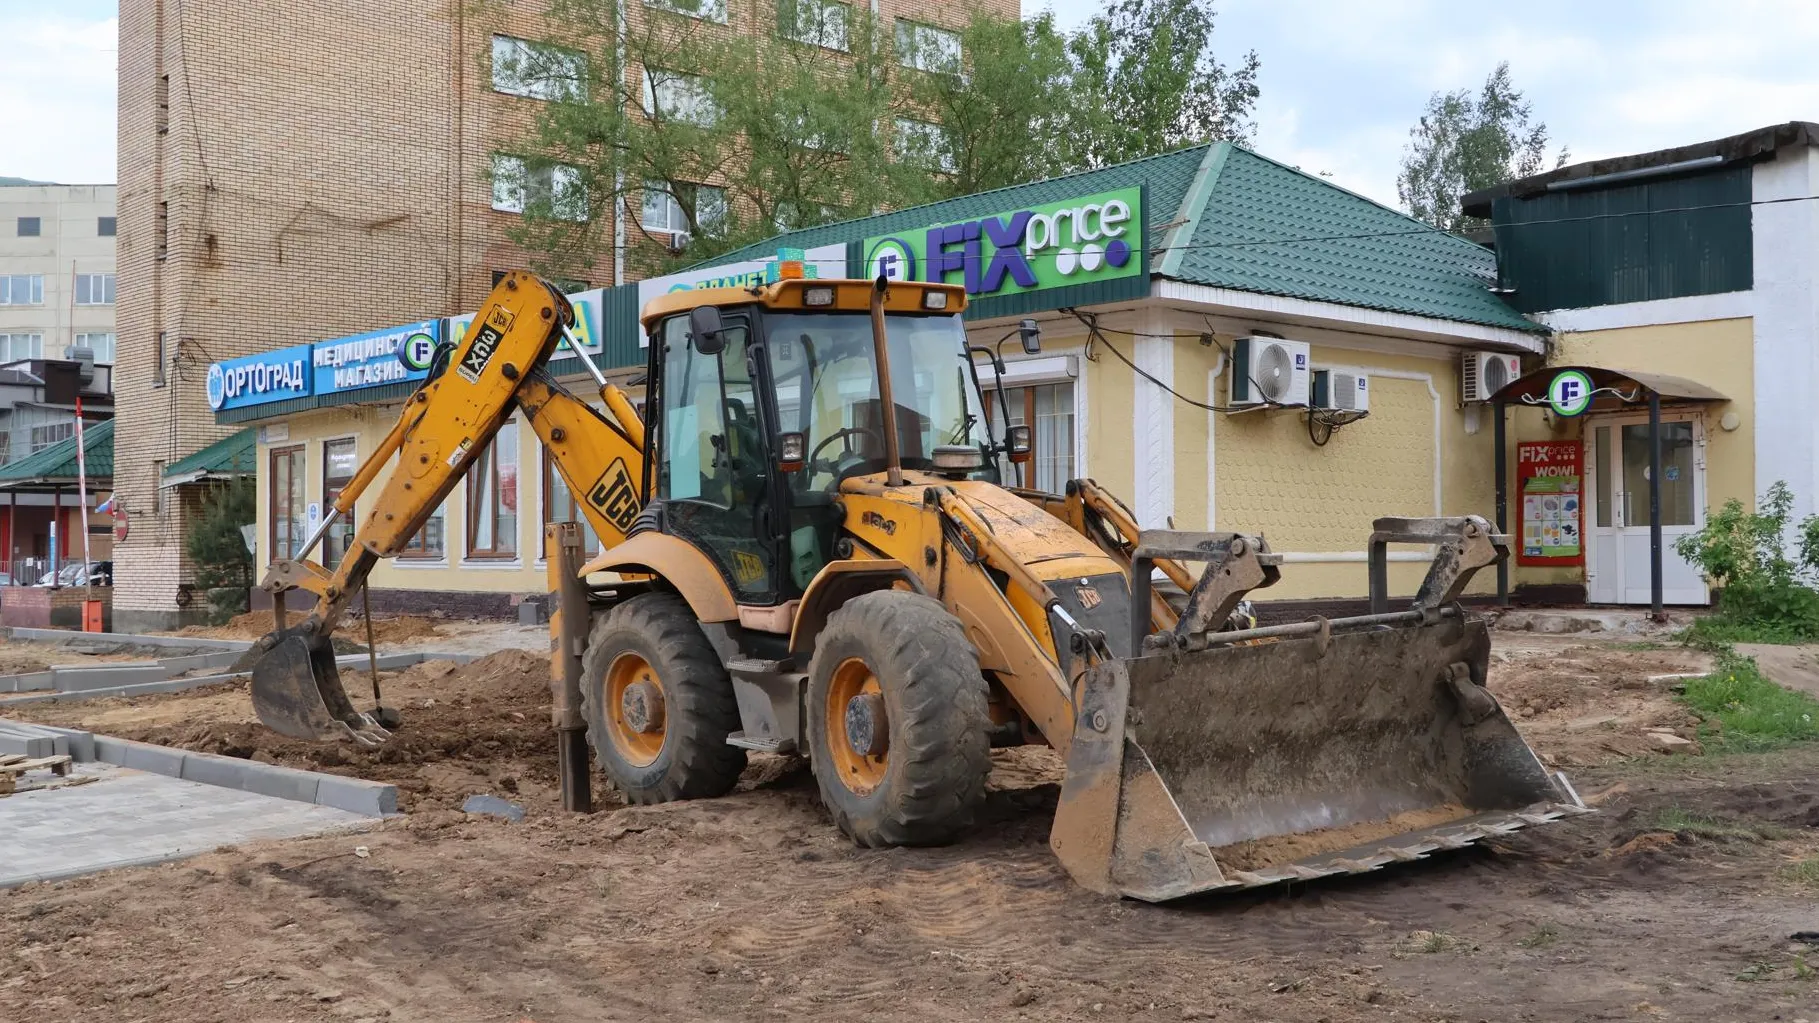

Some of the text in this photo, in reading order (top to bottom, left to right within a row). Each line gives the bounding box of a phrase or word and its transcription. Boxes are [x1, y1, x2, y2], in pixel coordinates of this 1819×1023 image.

[1026, 200, 1131, 260] price
[314, 323, 432, 368] МЕДИЦИНС
[224, 360, 304, 398] ОРТОГРАД
[334, 359, 408, 388] МАГАЗИН
[1549, 445, 1576, 456] price
[1534, 464, 1575, 478] WOW!
[592, 469, 640, 529] JCB
[735, 552, 764, 583] JCB
